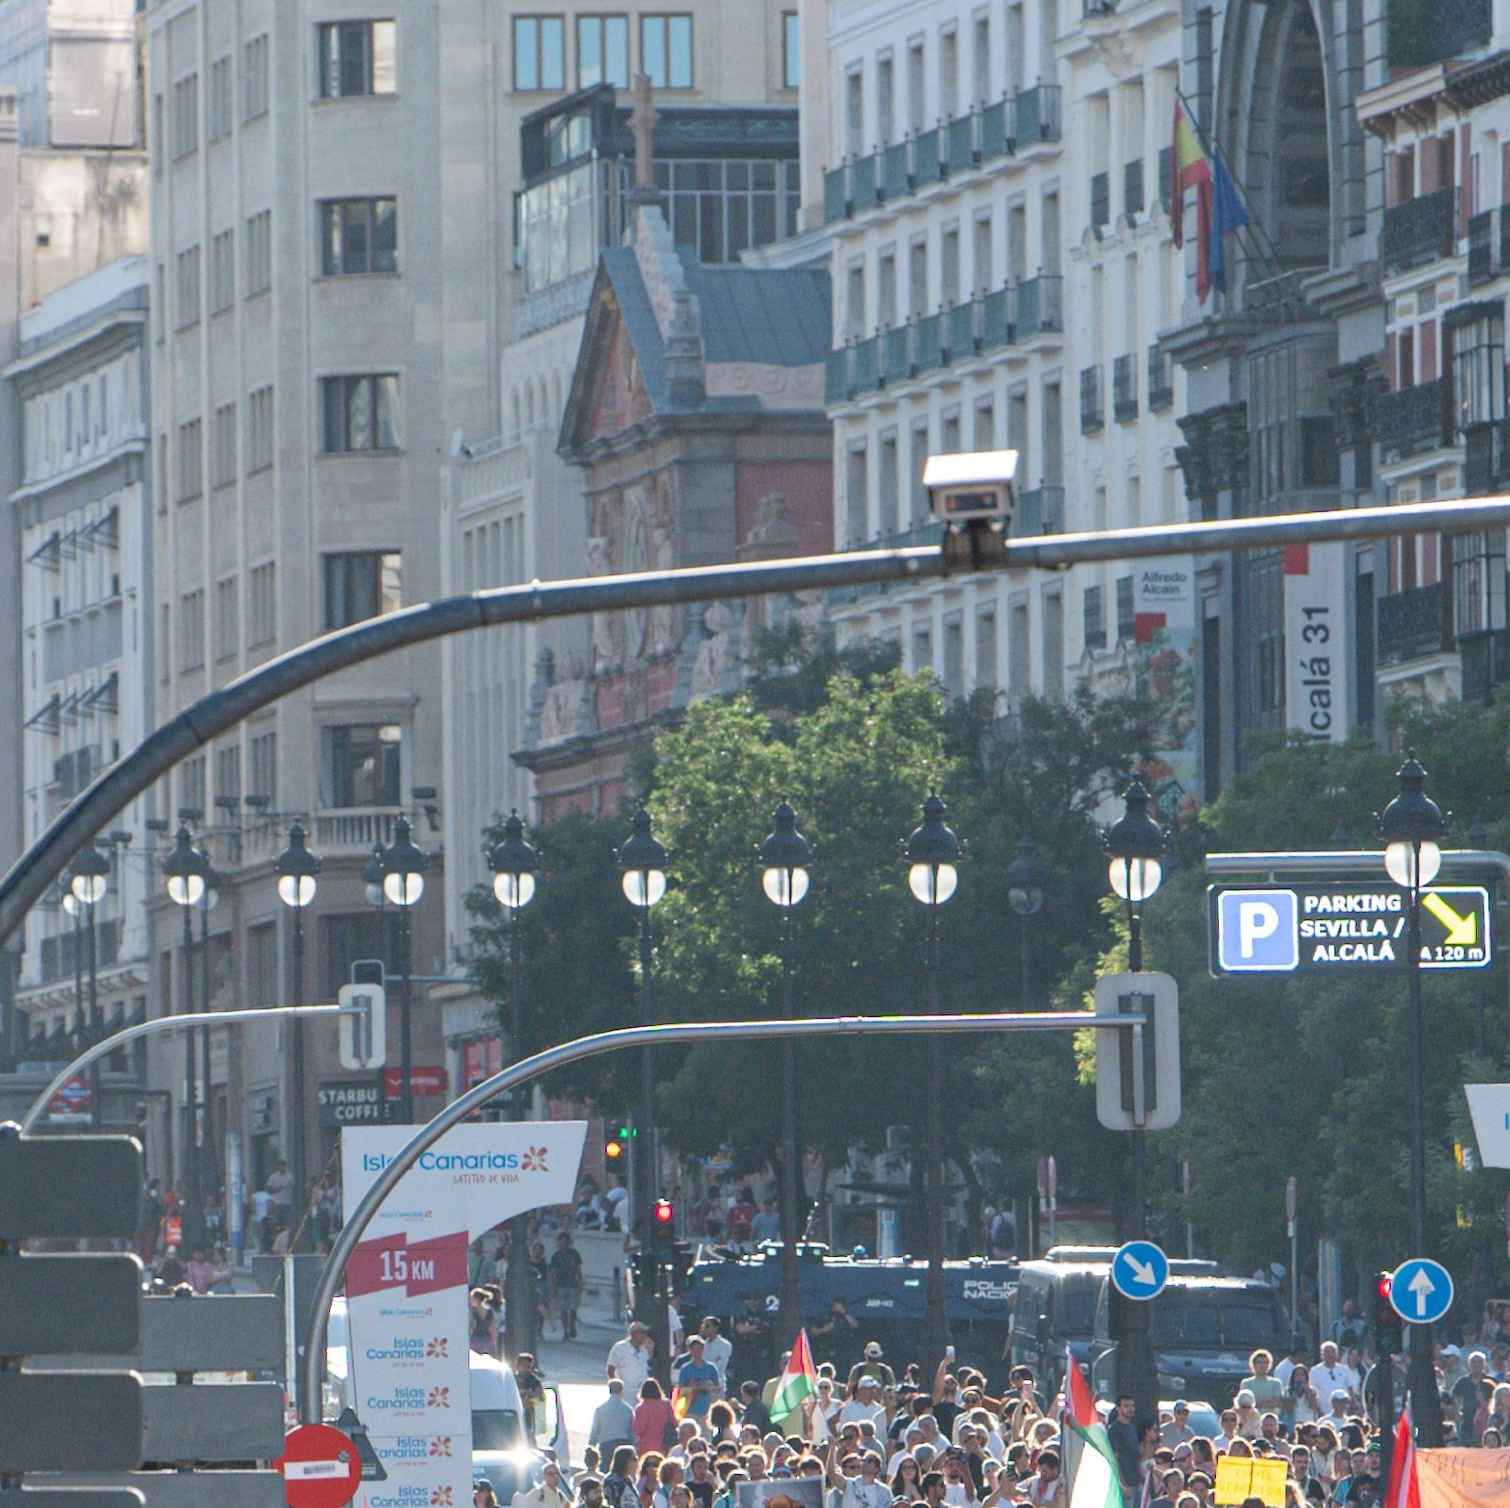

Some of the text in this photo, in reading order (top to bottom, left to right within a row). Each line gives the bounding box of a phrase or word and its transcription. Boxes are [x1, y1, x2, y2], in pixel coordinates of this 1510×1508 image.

[1142, 571, 1187, 583] Alfredo
[1299, 606, 1332, 740] lcalá 31
[1240, 895, 1402, 959] P PARKING
[1300, 919, 1388, 938] SEVILLA
[1312, 940, 1395, 961] ALCALÁ
[1420, 946, 1484, 960] A 120 m
[318, 1088, 377, 1105] STARBU
[335, 1104, 379, 1119] COFF
[363, 1152, 519, 1171] Isl Canarias
[380, 1250, 434, 1281] 15 KM
[964, 1280, 1019, 1290] POLIC
[393, 1337, 424, 1350] Islas
[366, 1347, 425, 1360] Canarias
[395, 1387, 425, 1399] Islas
[367, 1397, 426, 1409] Canarias
[397, 1436, 427, 1449] Islas
[398, 1485, 428, 1498] Islas
[371, 1496, 429, 1508] Canarias
